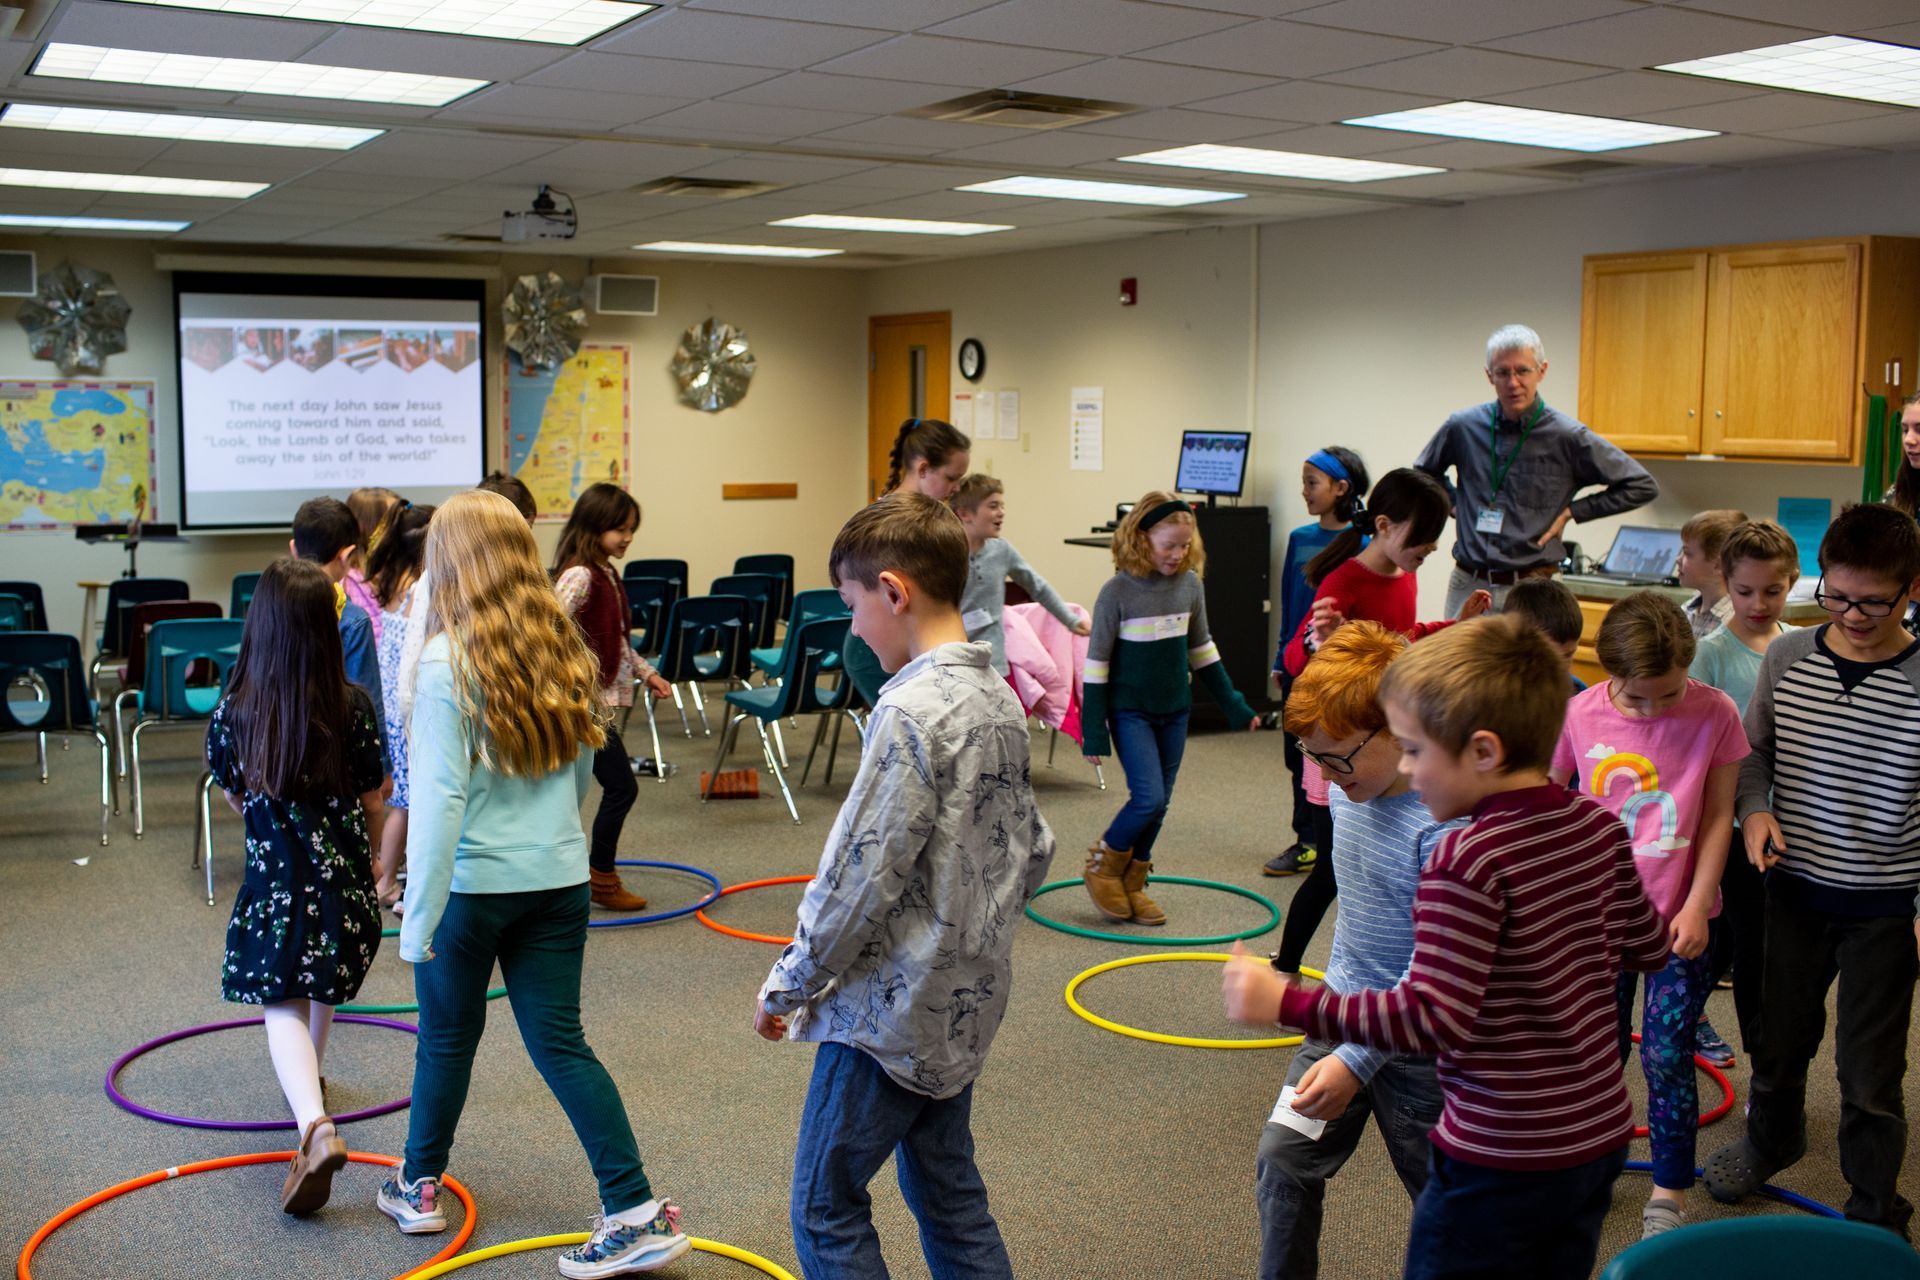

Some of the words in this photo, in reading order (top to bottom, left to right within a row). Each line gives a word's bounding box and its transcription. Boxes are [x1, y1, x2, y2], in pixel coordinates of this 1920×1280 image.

[228, 399, 256, 412] The
[262, 400, 294, 412] next
[300, 399, 329, 415] day
[334, 399, 367, 412] John
[373, 401, 400, 411] saw
[406, 399, 443, 411] Jesus
[225, 418, 282, 432] coming
[287, 418, 339, 429] toward
[345, 417, 372, 429] him
[377, 417, 406, 428] and
[411, 416, 445, 429] said,
[258, 434, 281, 446] the
[287, 433, 329, 446] Lamb
[335, 433, 349, 446] of
[355, 432, 388, 446] God,
[395, 433, 424, 444] who
[429, 432, 467, 444] takes
[235, 453, 276, 468] away
[282, 451, 305, 464] the
[312, 450, 333, 463] sin
[338, 450, 354, 462] of
[359, 450, 382, 461] the
[313, 468, 342, 481] John
